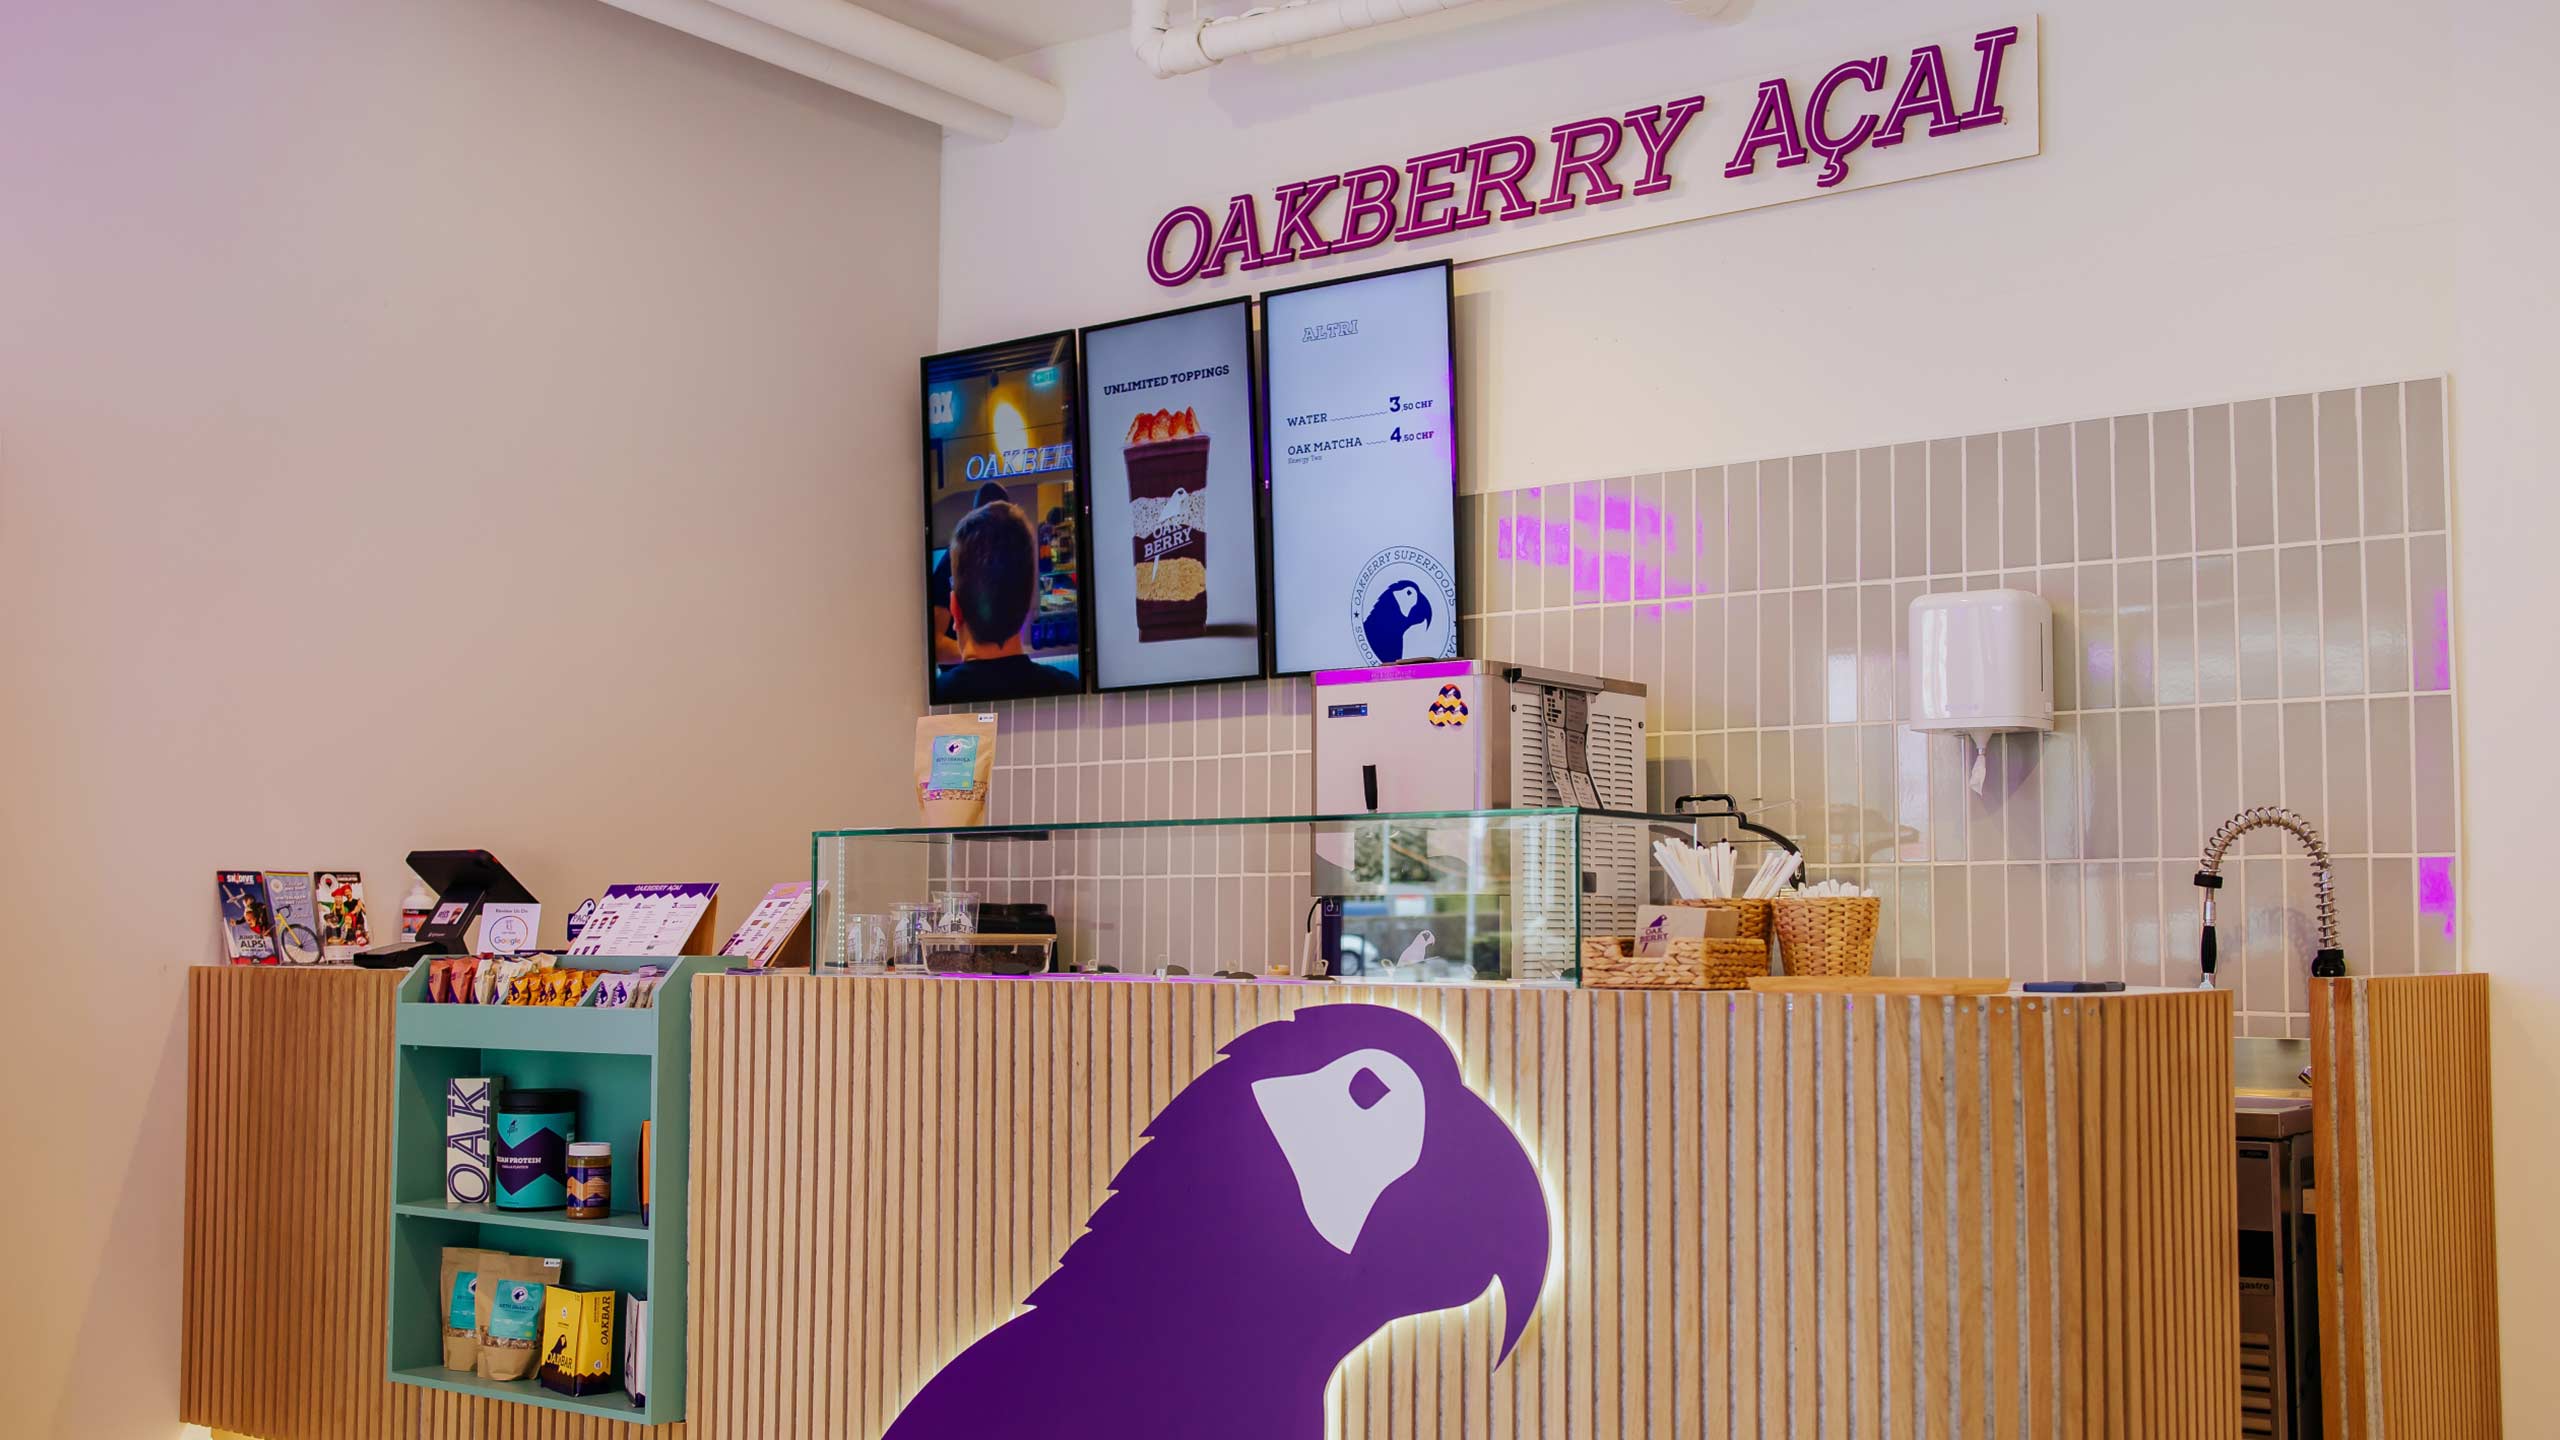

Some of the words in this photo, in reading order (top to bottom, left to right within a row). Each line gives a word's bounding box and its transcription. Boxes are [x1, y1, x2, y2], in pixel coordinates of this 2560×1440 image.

[1147, 95, 1705, 288] OAKBERRY
[1723, 26, 2018, 188] AÇAI
[1302, 319, 1359, 343] ALTRI
[1103, 375, 1169, 396] UNLIMITED
[1170, 364, 1230, 384] TOPPINGS
[1287, 413, 1328, 427] WATER
[1415, 400, 1434, 410] CHF
[1287, 443, 1312, 456] OAK
[1313, 437, 1363, 453] MATCHA
[1415, 431, 1435, 440] CHF
[1144, 526, 1193, 558] BERRY
[1153, 521, 1182, 539] OAK
[1354, 552, 1392, 606] OAKBERRY
[1394, 550, 1456, 607] SUPERFOODS
[1640, 932, 1669, 943] BERRY
[1645, 928, 1663, 936] OAK
[447, 1078, 491, 1203] OAK
[601, 1296, 611, 1345] OAKBAR
